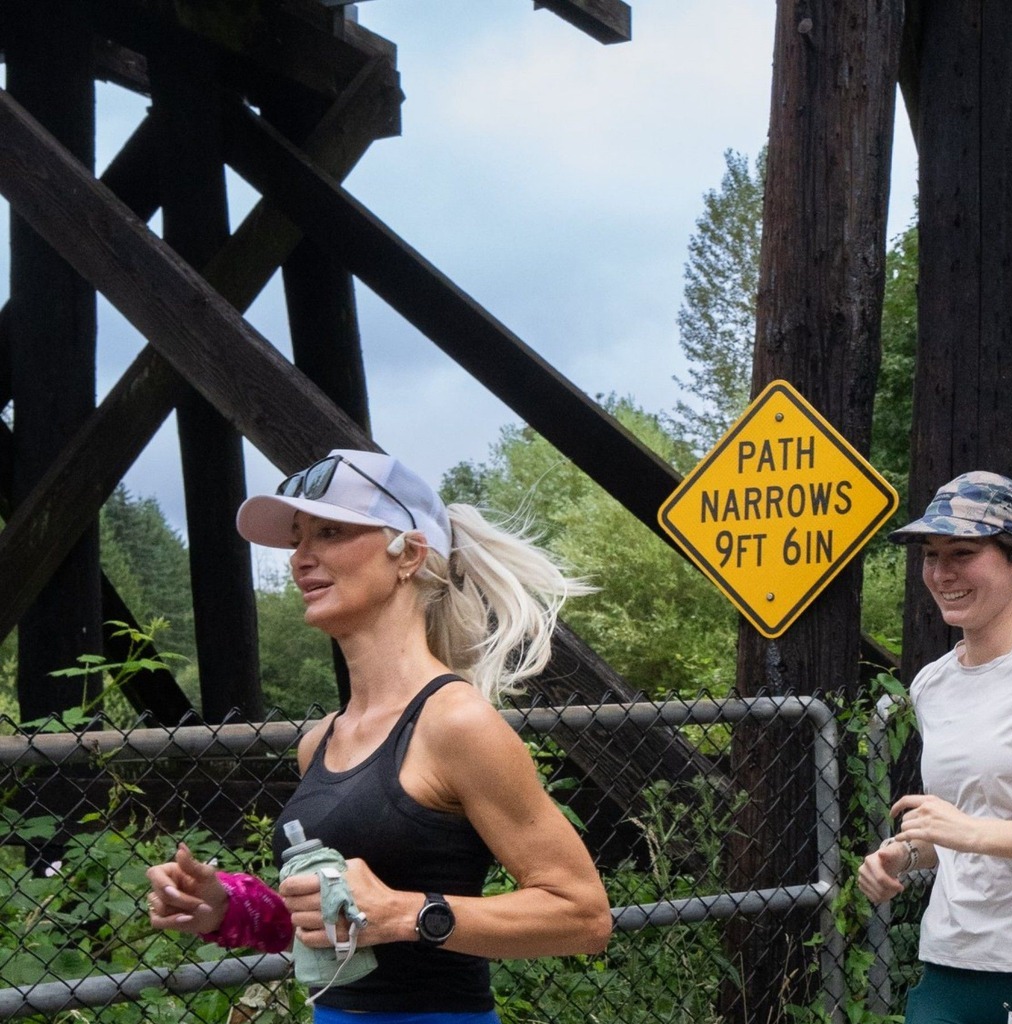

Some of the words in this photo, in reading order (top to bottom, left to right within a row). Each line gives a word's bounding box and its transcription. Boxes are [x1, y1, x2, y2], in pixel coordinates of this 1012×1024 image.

[738, 436, 815, 473] PATH
[701, 480, 853, 523] NARROWS
[715, 530, 767, 568] 9FT
[782, 527, 833, 566] 6IN
